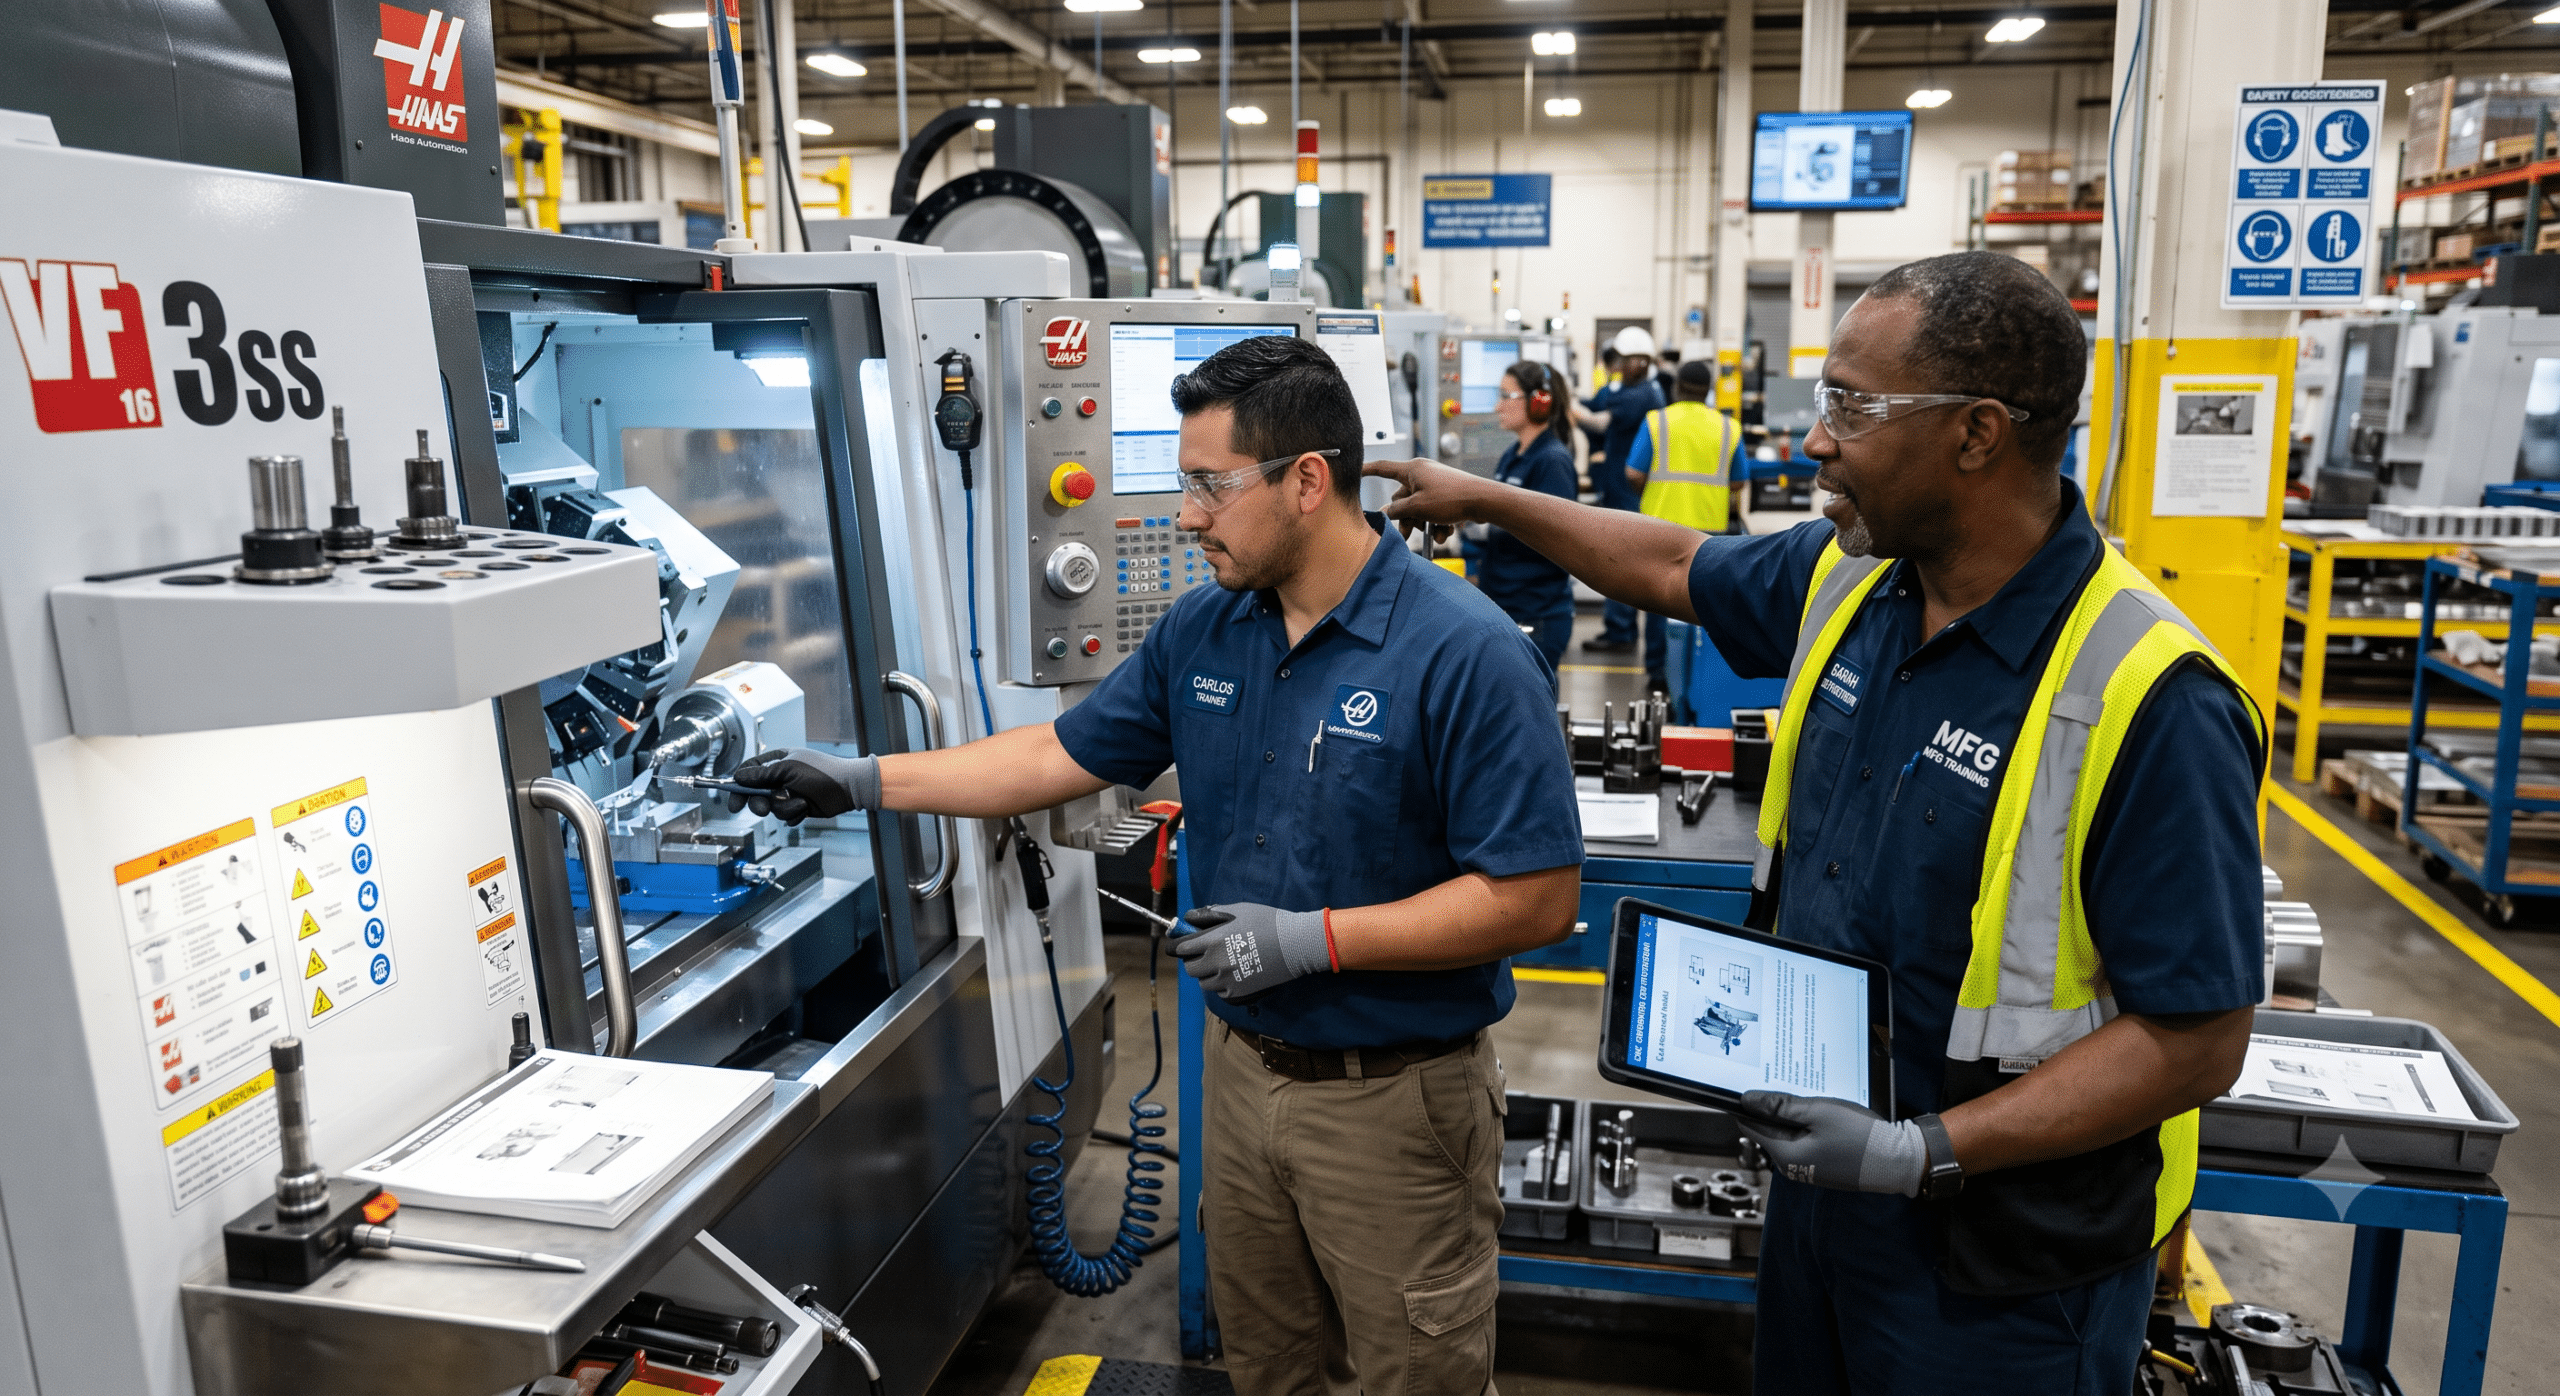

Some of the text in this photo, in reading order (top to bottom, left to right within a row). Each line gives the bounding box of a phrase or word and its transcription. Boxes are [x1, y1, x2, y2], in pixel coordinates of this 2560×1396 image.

[387, 94, 466, 134] HAAS
[417, 138, 468, 154] Automation
[0, 258, 124, 381] VF
[1047, 352, 1087, 365] HAAS
[119, 388, 156, 424] 16
[1193, 675, 1235, 695] CARLOS
[1931, 720, 2000, 772] MFG
[1922, 745, 1990, 788] MFG TRAINING
